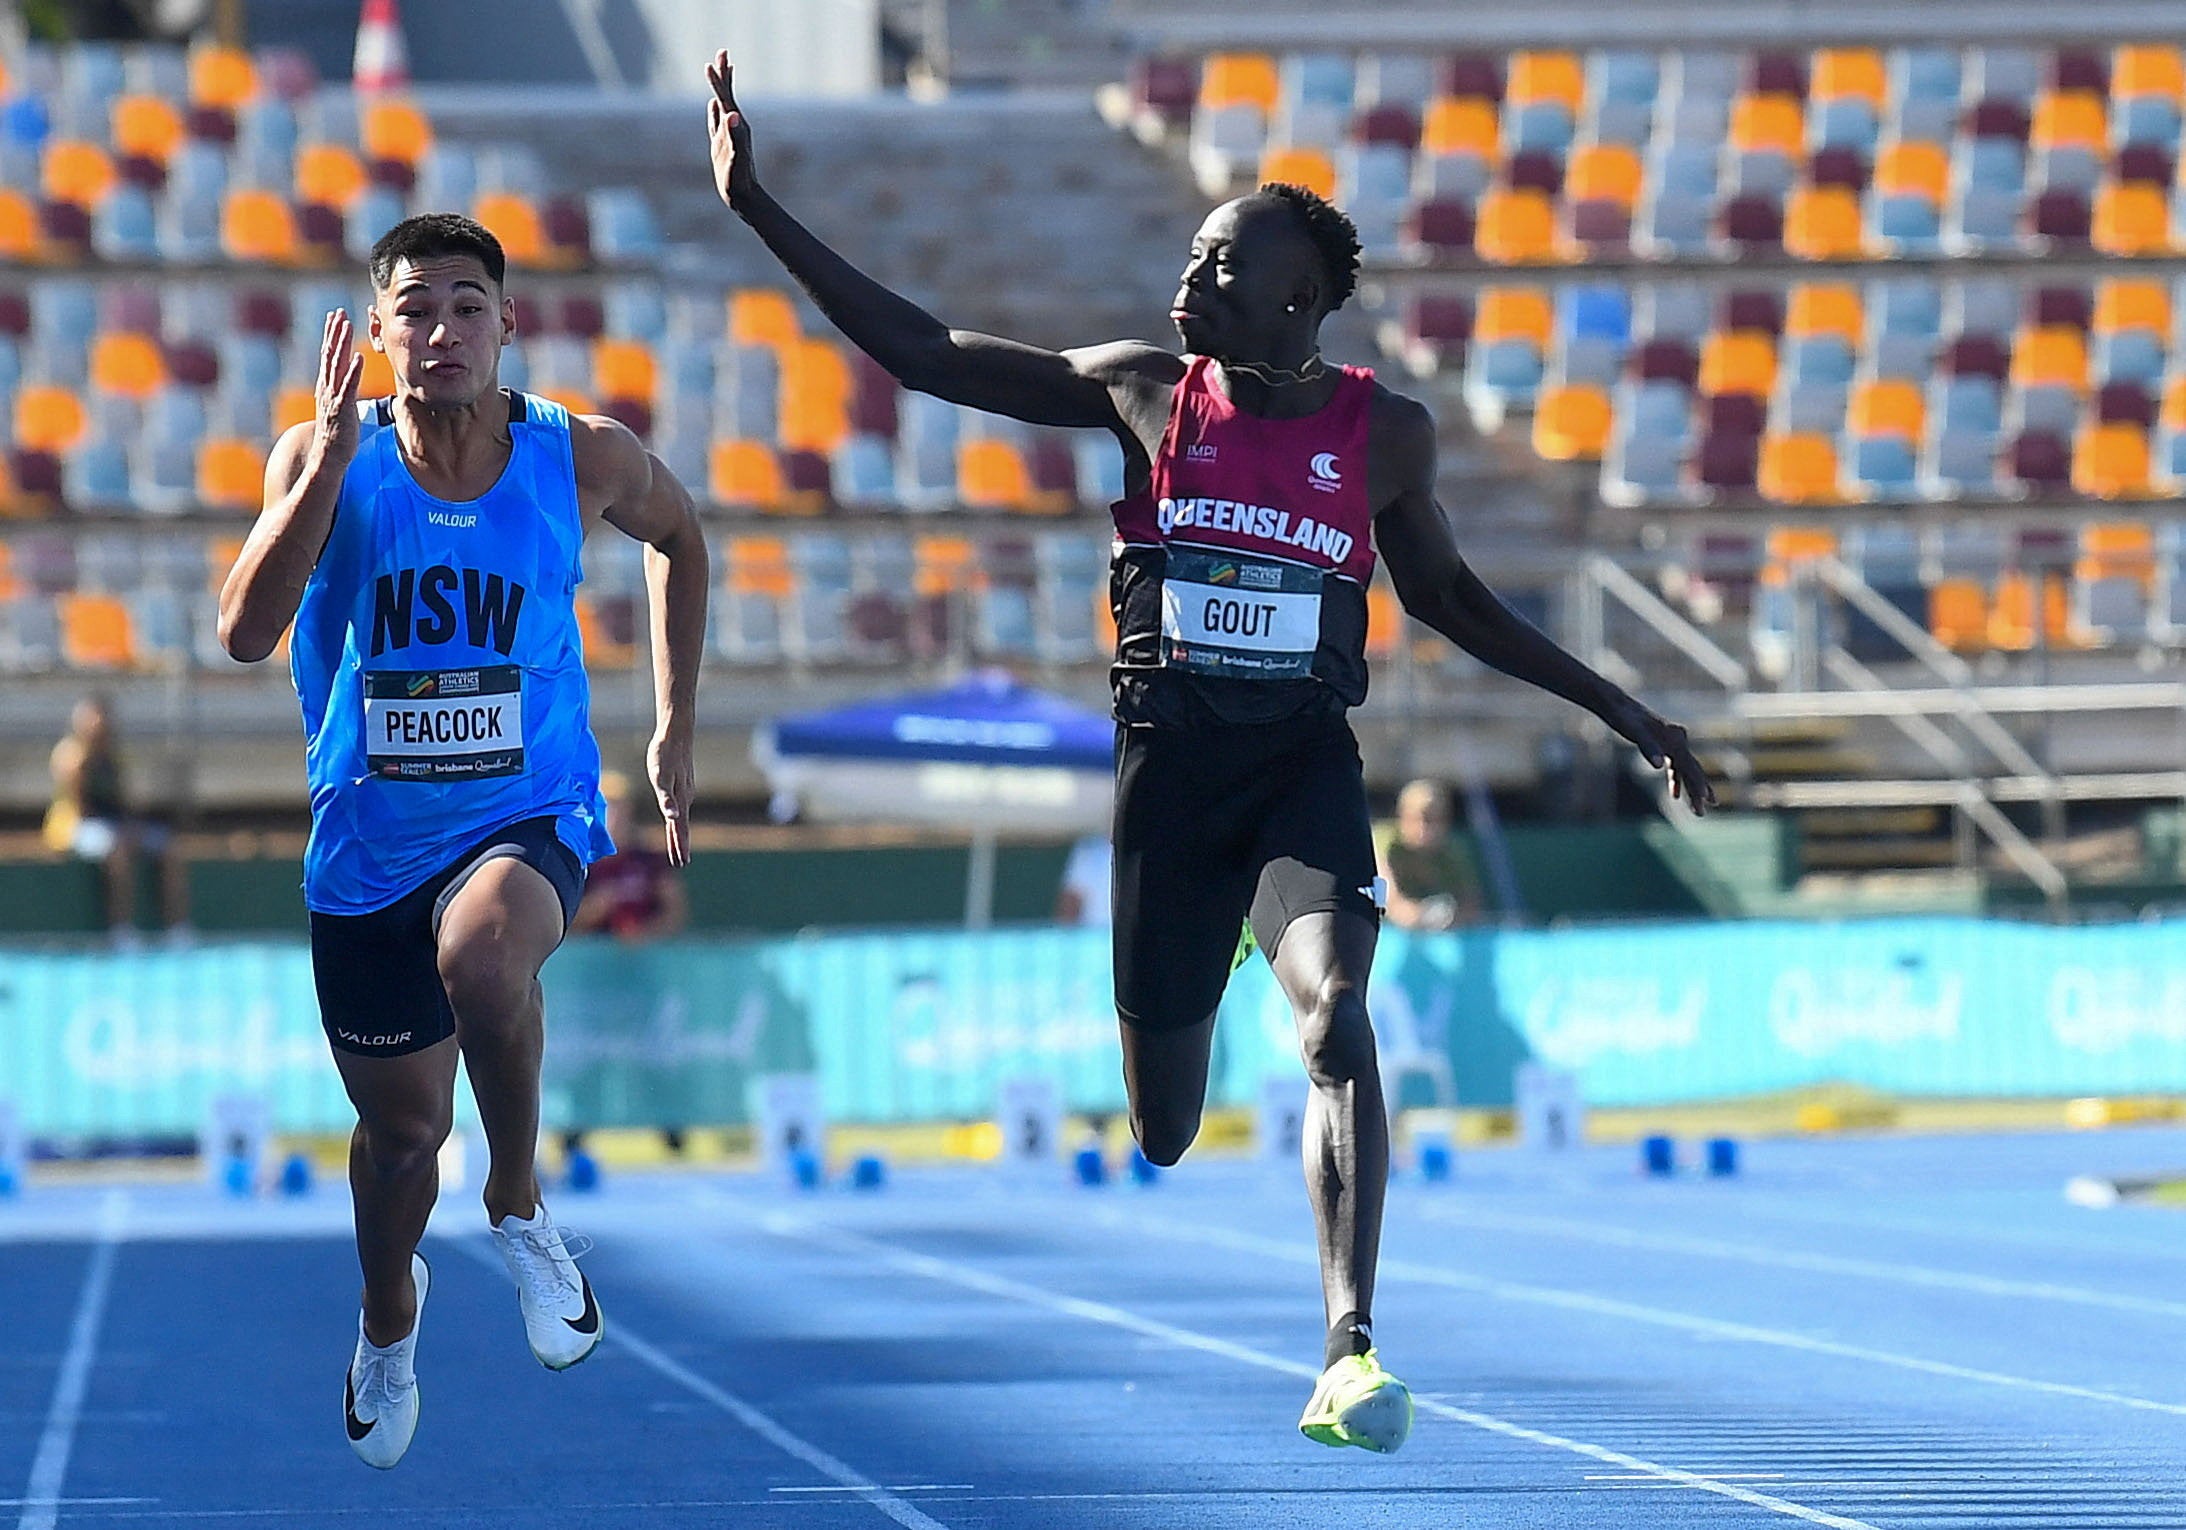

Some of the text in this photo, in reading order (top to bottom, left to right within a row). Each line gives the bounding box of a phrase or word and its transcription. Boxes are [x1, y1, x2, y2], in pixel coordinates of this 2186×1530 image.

[428, 512, 476, 527] VALOUR
[1157, 497, 1354, 564] QUEENSLAND
[370, 565, 526, 657] NSW
[1203, 598, 1277, 638] GOUT
[386, 706, 503, 744] PEACOCK
[435, 763, 473, 773] brisbane
[338, 1027, 412, 1046] VALOUR
